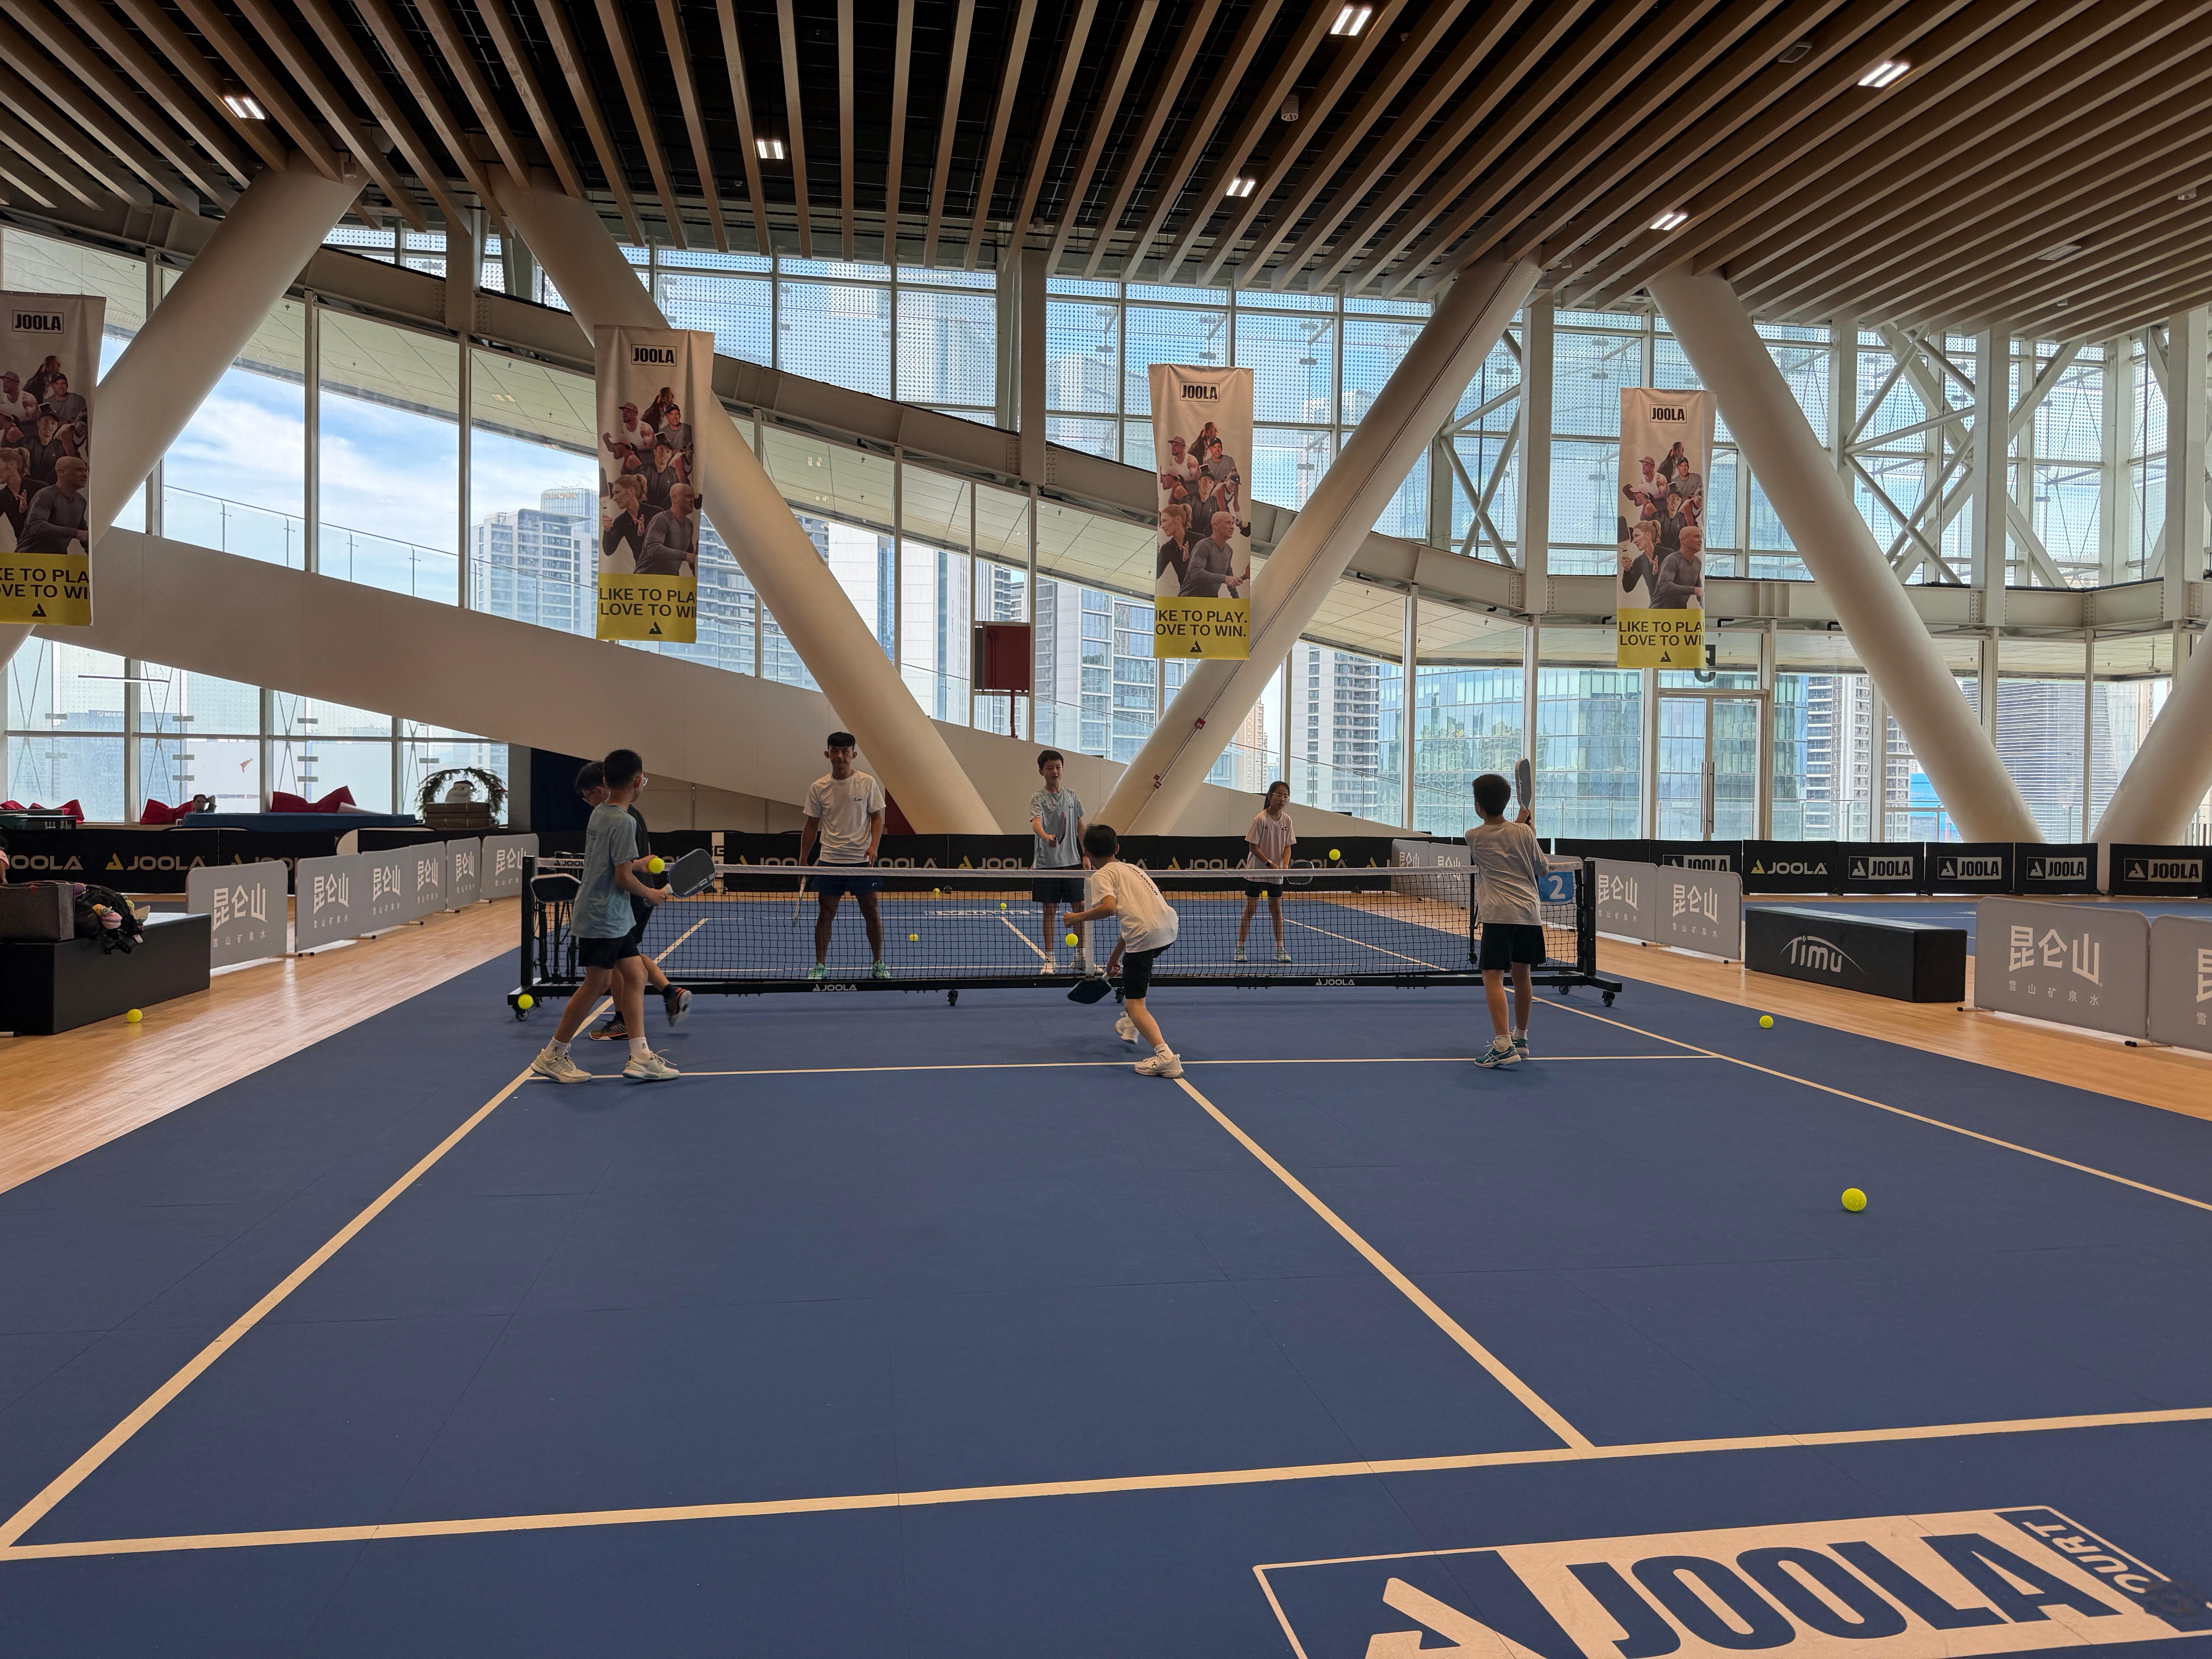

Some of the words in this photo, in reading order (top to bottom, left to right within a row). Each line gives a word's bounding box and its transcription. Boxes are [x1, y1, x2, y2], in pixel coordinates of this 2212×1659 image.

[15, 314, 61, 330] JOOLA
[634, 348, 674, 363] JOOLA
[1182, 385, 1217, 400] JOOLA
[1652, 408, 1685, 421] JOOLA
[20, 568, 46, 581] TO
[53, 570, 89, 584] PLA
[0, 584, 25, 597] VE
[31, 585, 57, 598] TO
[64, 586, 88, 599] WI
[600, 587, 633, 600] LIKE
[638, 589, 661, 601] TO
[667, 590, 696, 603] PLA
[601, 603, 643, 615] LOVE
[648, 604, 672, 617] TO
[676, 605, 696, 618] WI
[1182, 610, 1202, 622] TO
[1207, 611, 1247, 623] PLAY.
[1156, 624, 1186, 635] OVE
[1190, 625, 1210, 635] TO
[1215, 625, 1246, 637] WIN.
[1619, 622, 1648, 632] LIKE
[1652, 622, 1671, 632] TO
[1676, 622, 1704, 633] PLA
[1620, 635, 1656, 646] LOVE
[1660, 635, 1679, 646] TO
[127, 855, 205, 871] JOOLA
[456, 852, 474, 882] 昆仑山
[878, 857, 938, 869] OOLA
[977, 858, 1033, 869] JOOL
[1185, 859, 1247, 870] JOOLA
[1767, 862, 1828, 874] JOOLA
[1871, 860, 1910, 876] JOOLA
[1960, 861, 1999, 876] JOOLA
[2048, 861, 2084, 876] JOOLA
[2151, 863, 2199, 878] JOOLA
[417, 858, 438, 891] 昆仑山
[373, 865, 400, 902] 昆仑山
[1548, 875, 1565, 899] 2
[1598, 874, 1638, 909] 昆仑山
[314, 872, 349, 914] 昆仑山
[213, 883, 266, 931] 昆仑山
[1673, 884, 1717, 923] 昆仑山
[1780, 935, 1842, 973] Timu
[2009, 925, 2099, 985] 昆仑山
[2009, 981, 2099, 1005] 雪山矿泉水
[1565, 1533, 2124, 1659] JOOLA
